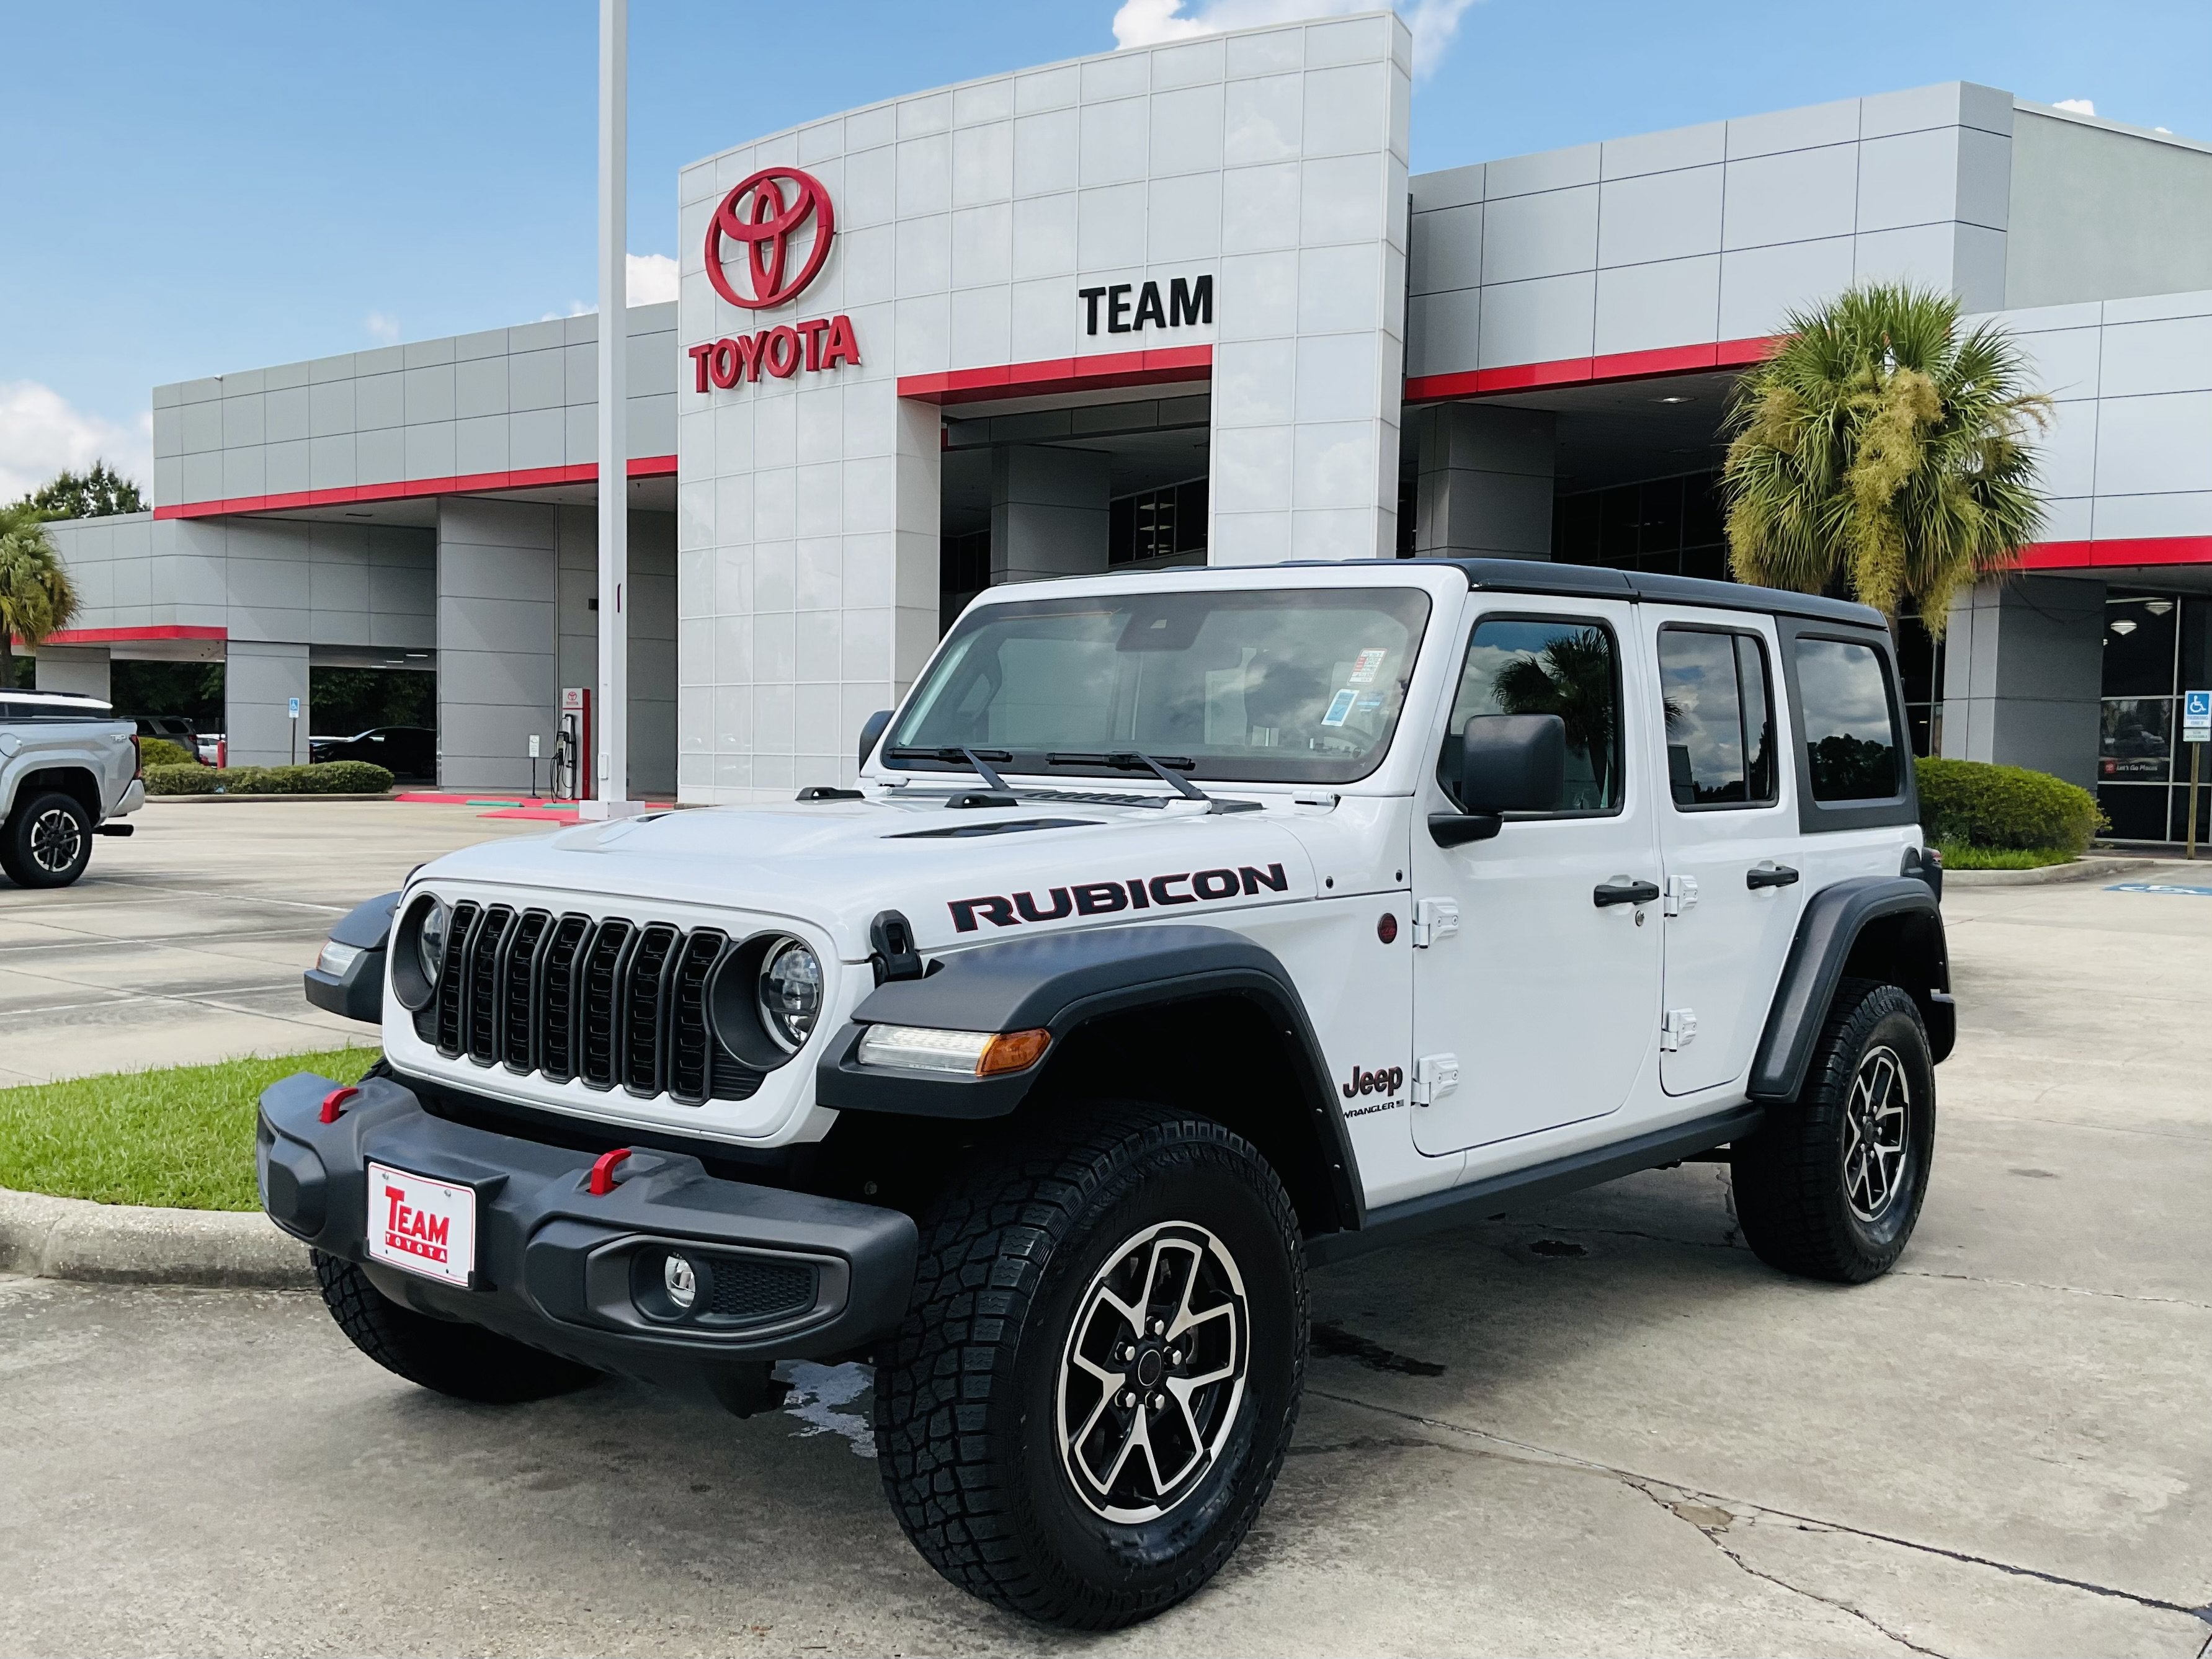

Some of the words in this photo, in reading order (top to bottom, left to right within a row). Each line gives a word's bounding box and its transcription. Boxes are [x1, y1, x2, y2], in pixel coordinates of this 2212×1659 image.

[1079, 274, 1213, 336] TEAM
[689, 314, 861, 394] TOYOTA
[947, 863, 1288, 933] RUBICON
[1343, 1065, 1403, 1098] Jeep
[1343, 1102, 1394, 1118] WRANGLER
[385, 1185, 450, 1245] TEAM
[386, 1234, 447, 1261] TOYOTA
